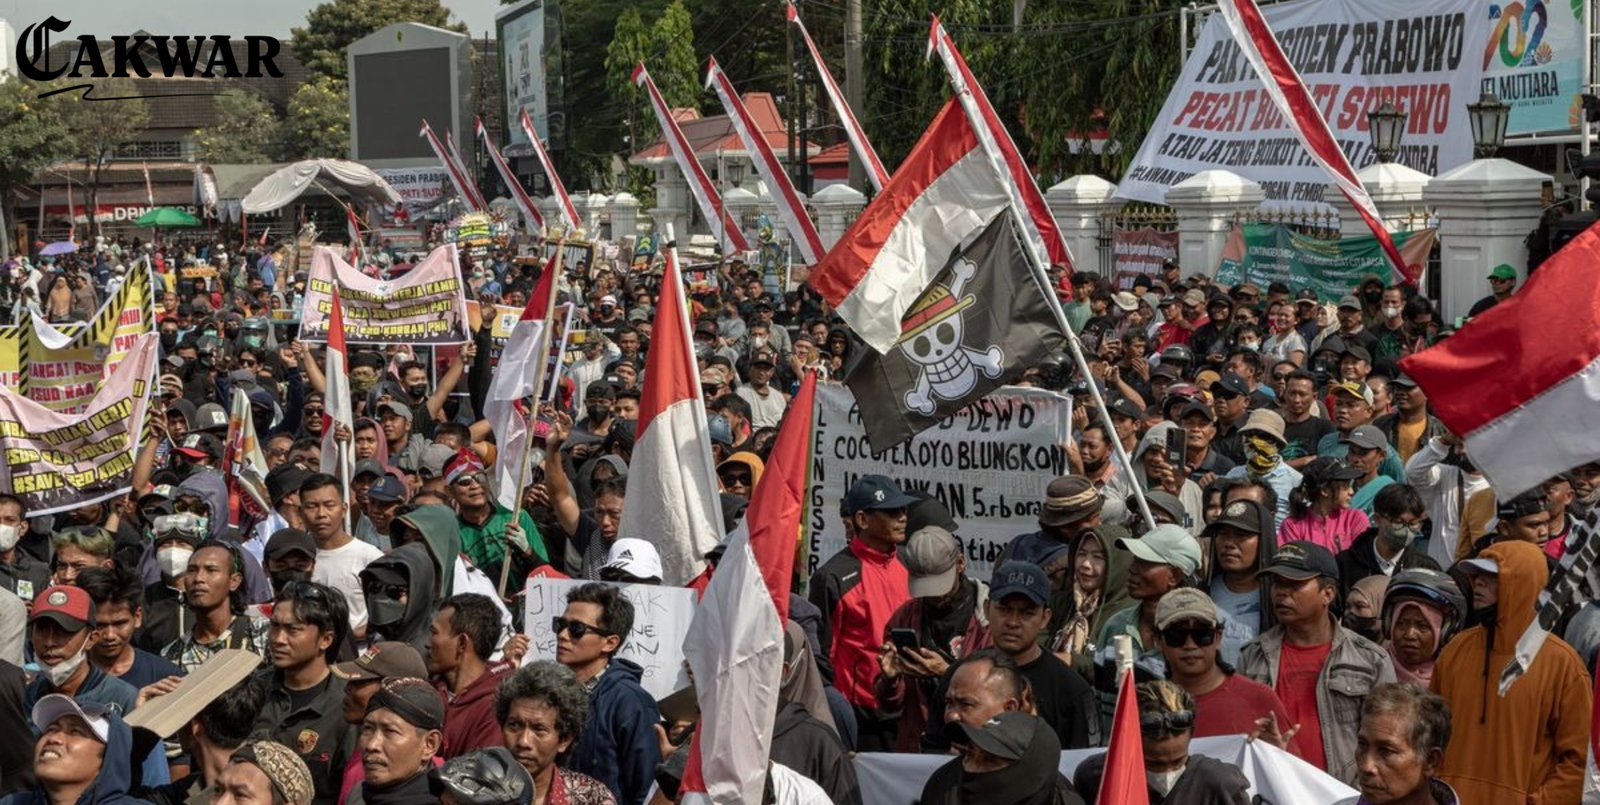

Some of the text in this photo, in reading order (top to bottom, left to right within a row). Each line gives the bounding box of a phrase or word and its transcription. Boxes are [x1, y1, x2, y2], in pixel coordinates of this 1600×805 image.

[1342, 13, 1465, 75] PRABOWO
[1499, 71, 1559, 100] MUTIARA
[1173, 90, 1255, 132] PECAT
[1158, 133, 1204, 160] ATAU
[1200, 136, 1252, 166] JATENG
[1251, 138, 1301, 166] BOIKOT
[957, 441, 1067, 477] BLUNGKON
[1007, 571, 1035, 586] GAP
